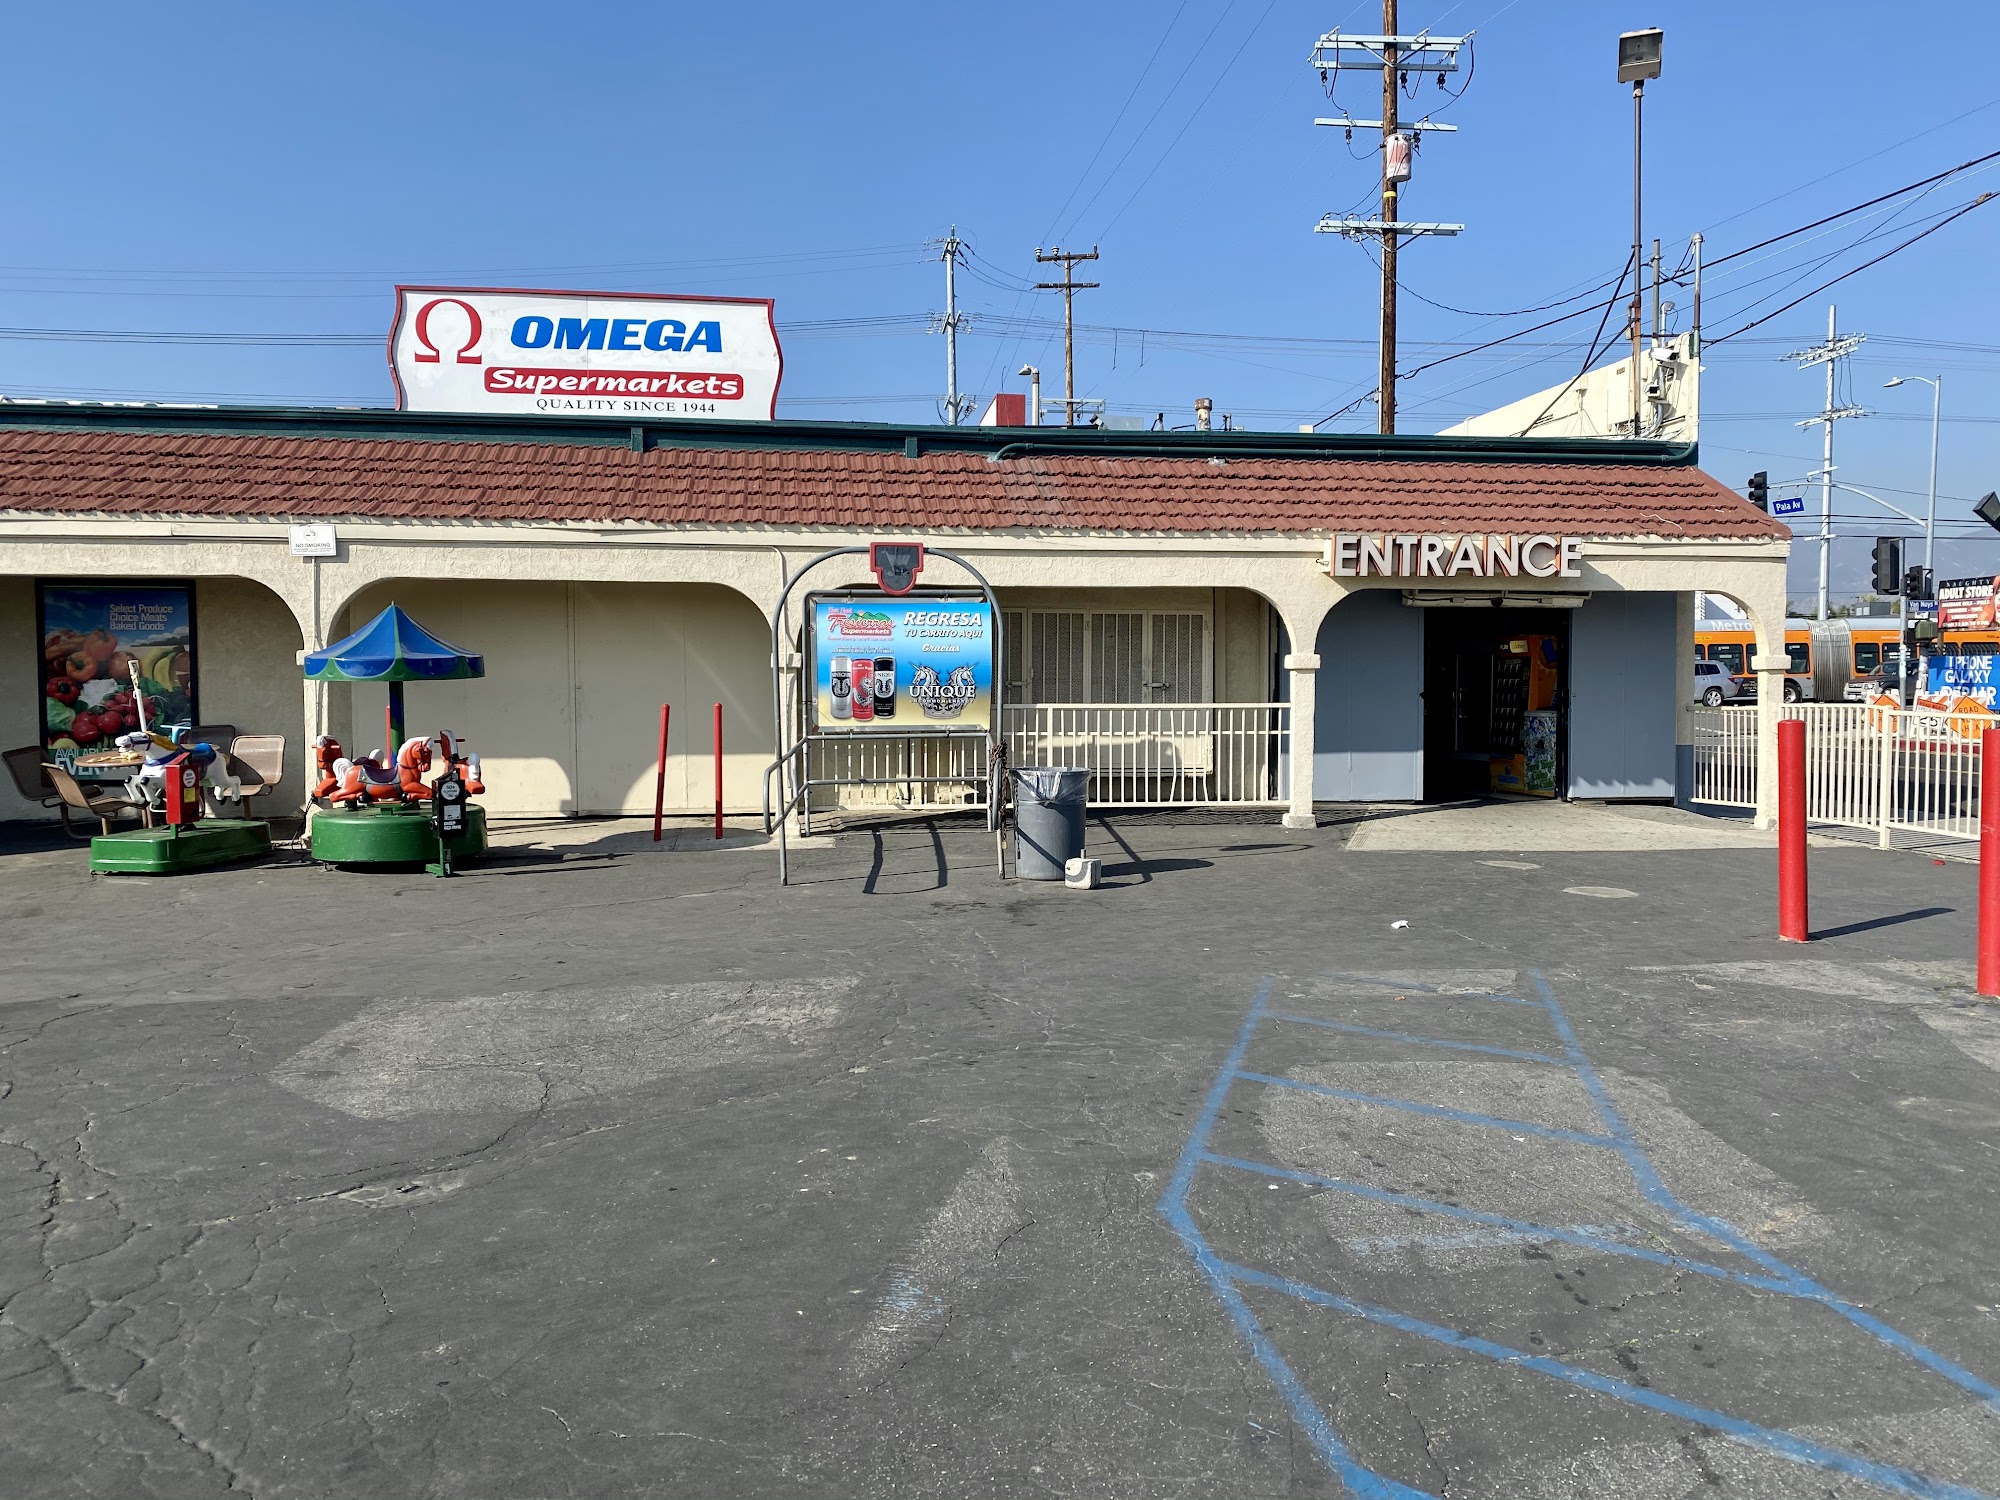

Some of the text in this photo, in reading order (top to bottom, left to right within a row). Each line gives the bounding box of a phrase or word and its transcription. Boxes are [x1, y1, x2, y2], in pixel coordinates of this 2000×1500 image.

[510, 315, 723, 353] OMEGA
[489, 368, 738, 396] Supermarkets
[536, 398, 716, 414] QUALITY SINCE 1944
[1775, 500, 1801, 512] Pala Av
[1332, 535, 1583, 578] ENTRANCE
[1939, 585, 1994, 600] ADULT STORE
[109, 603, 174, 613] Select Produce
[1920, 601, 1933, 609] Nuys
[109, 612, 168, 622] Choice Meats
[903, 611, 983, 626] REGRESA
[109, 622, 166, 631] Baked Goods
[841, 627, 890, 635] Supermarkets
[1710, 620, 1753, 631] Metro
[904, 629, 984, 639] TU CARRITO AQUI
[922, 643, 961, 653] Gracias
[1945, 669, 1991, 684] GALAXY
[908, 685, 976, 698] UNIQUE
[1958, 705, 1979, 714] ROAD
